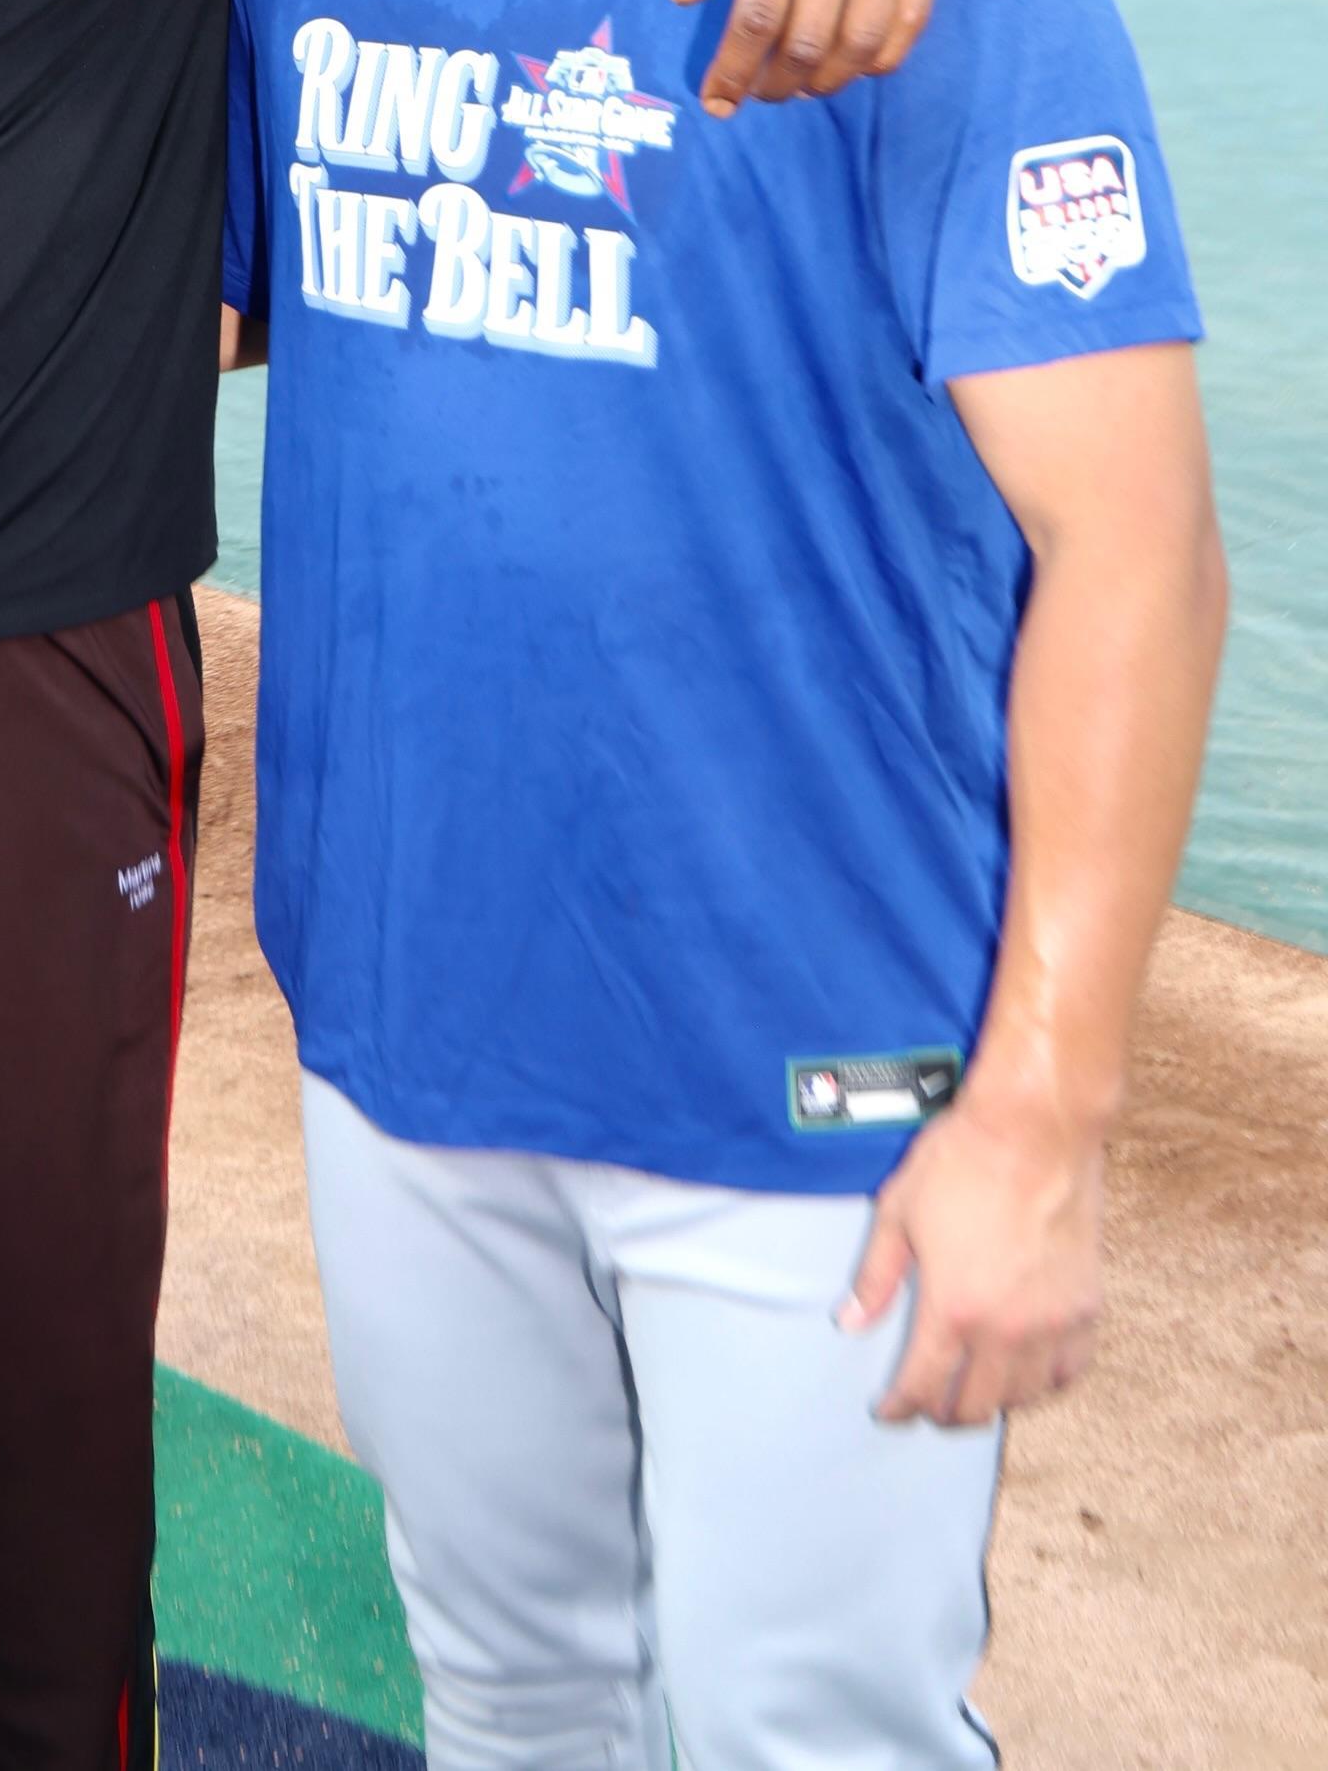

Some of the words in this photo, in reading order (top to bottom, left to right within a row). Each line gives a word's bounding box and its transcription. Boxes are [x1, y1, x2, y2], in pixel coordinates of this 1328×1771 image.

[292, 16, 500, 183] RING
[1019, 155, 1125, 206] USA
[290, 161, 418, 329] THE
[417, 183, 660, 368] BELL
